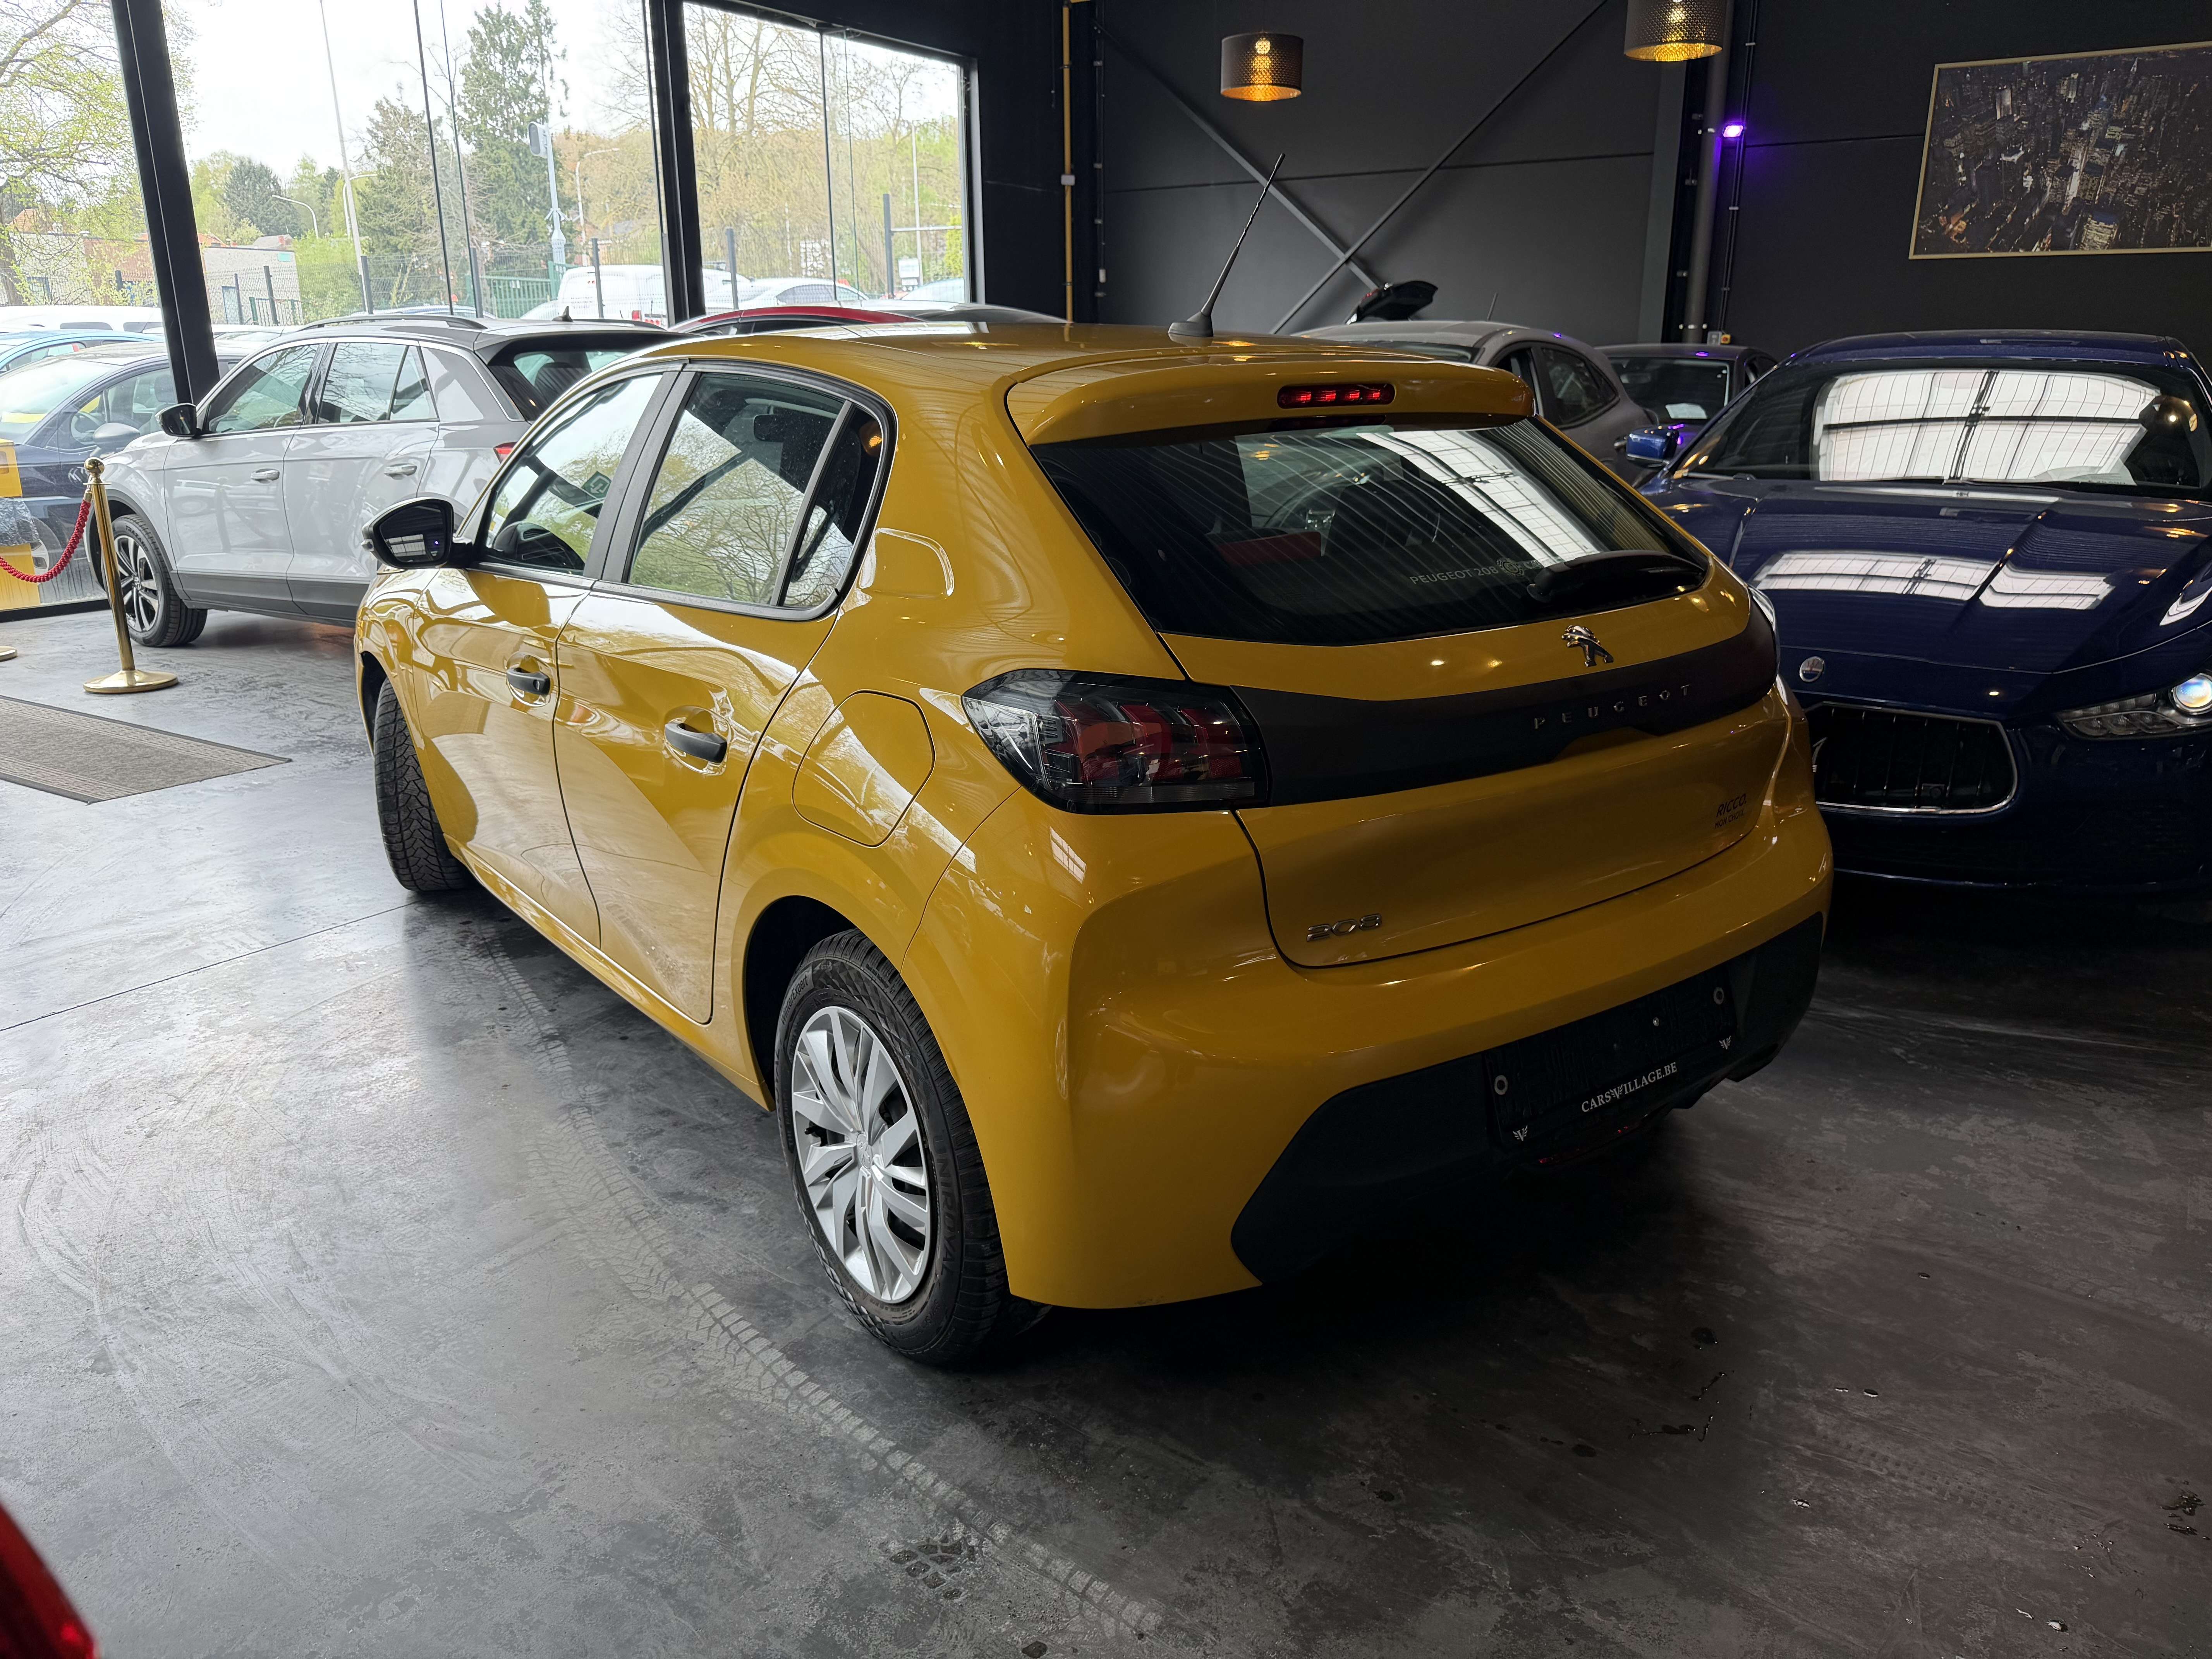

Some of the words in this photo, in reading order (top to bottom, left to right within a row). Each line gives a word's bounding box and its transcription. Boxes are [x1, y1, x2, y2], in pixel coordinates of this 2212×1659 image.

[125, 525, 148, 552] TRAZANO
[1409, 569, 1473, 584] PEUGEOT
[1474, 566, 1499, 576] 208
[1534, 684, 1690, 729] PEUGEOT
[1306, 913, 1382, 942] 208
[781, 974, 809, 1026] WinterExpert
[1581, 1061, 1678, 1113] CARSVILLAGE.BE
[933, 1135, 956, 1276] UNIROYAL
